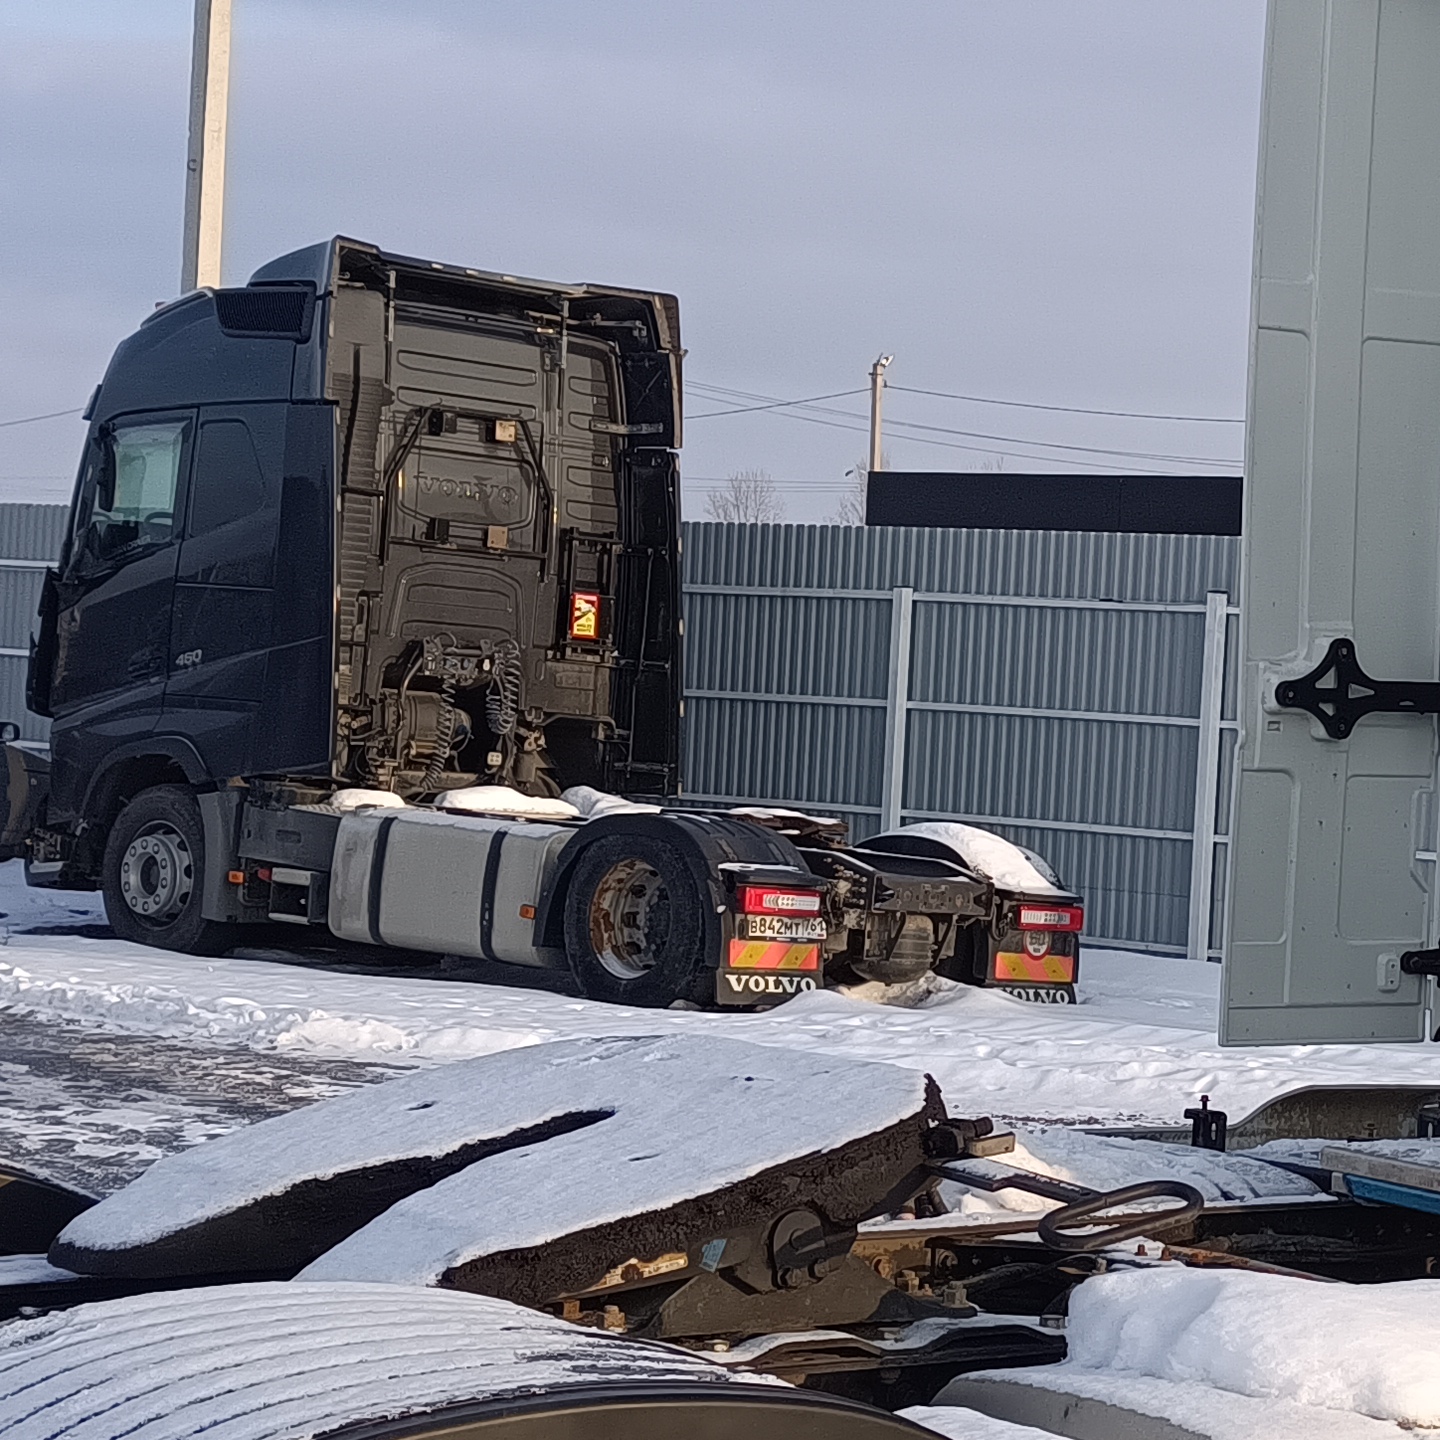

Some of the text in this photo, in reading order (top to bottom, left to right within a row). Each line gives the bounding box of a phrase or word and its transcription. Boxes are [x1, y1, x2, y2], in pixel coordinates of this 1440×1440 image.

[175, 649, 203, 666] 460
[725, 974, 817, 994] VOLVO
[1001, 987, 1070, 1006] OLVO
